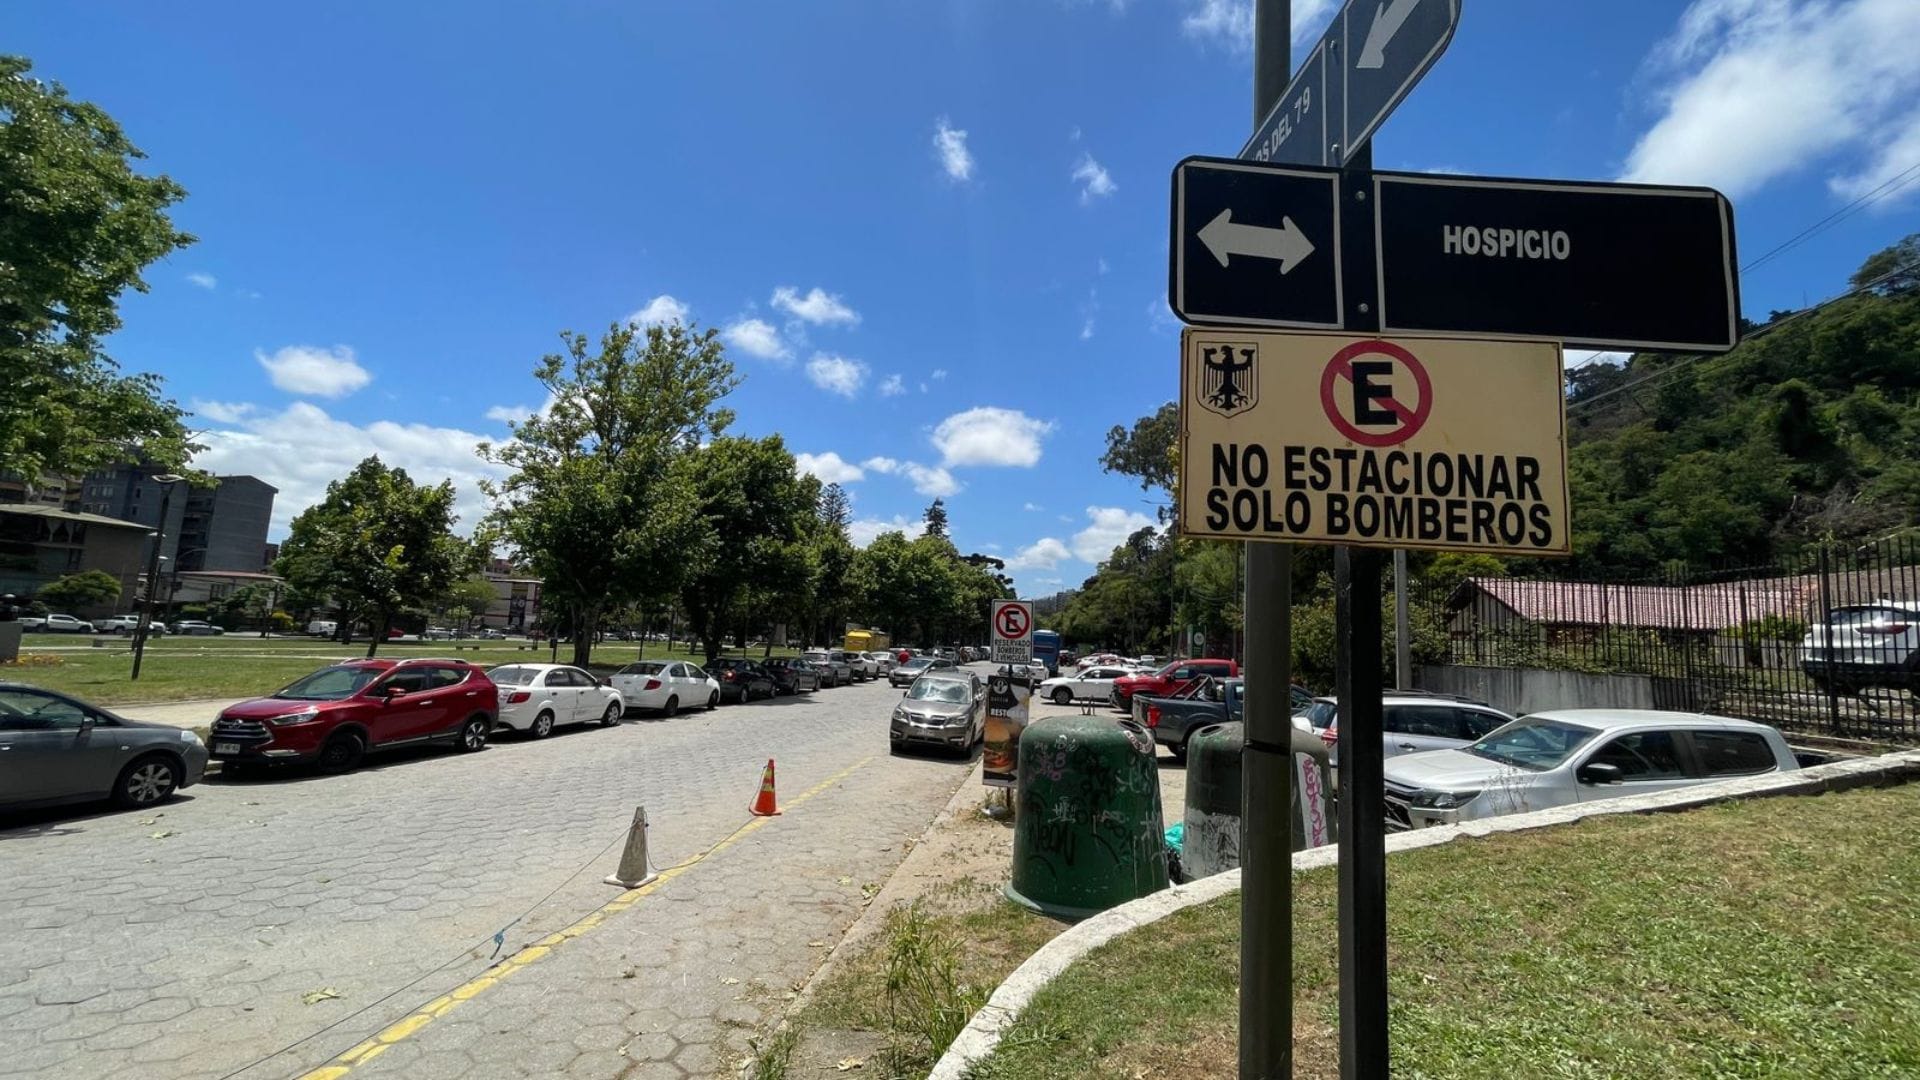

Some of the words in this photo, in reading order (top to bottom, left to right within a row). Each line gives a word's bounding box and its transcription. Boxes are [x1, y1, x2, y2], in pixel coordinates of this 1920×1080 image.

[1271, 113, 1292, 156] DEL
[1294, 86, 1310, 124] 79
[1443, 224, 1570, 260] HOSPICIO
[1351, 361, 1398, 425] E
[1212, 443, 1268, 488] NO
[1284, 446, 1542, 501] ESTACIONAR
[1206, 488, 1311, 534] SOLO
[1326, 493, 1552, 547] BOMBEROS
[994, 639, 1031, 647] RESERVADO
[1005, 610, 1020, 632] E
[997, 646, 1026, 654] BOMBEROS
